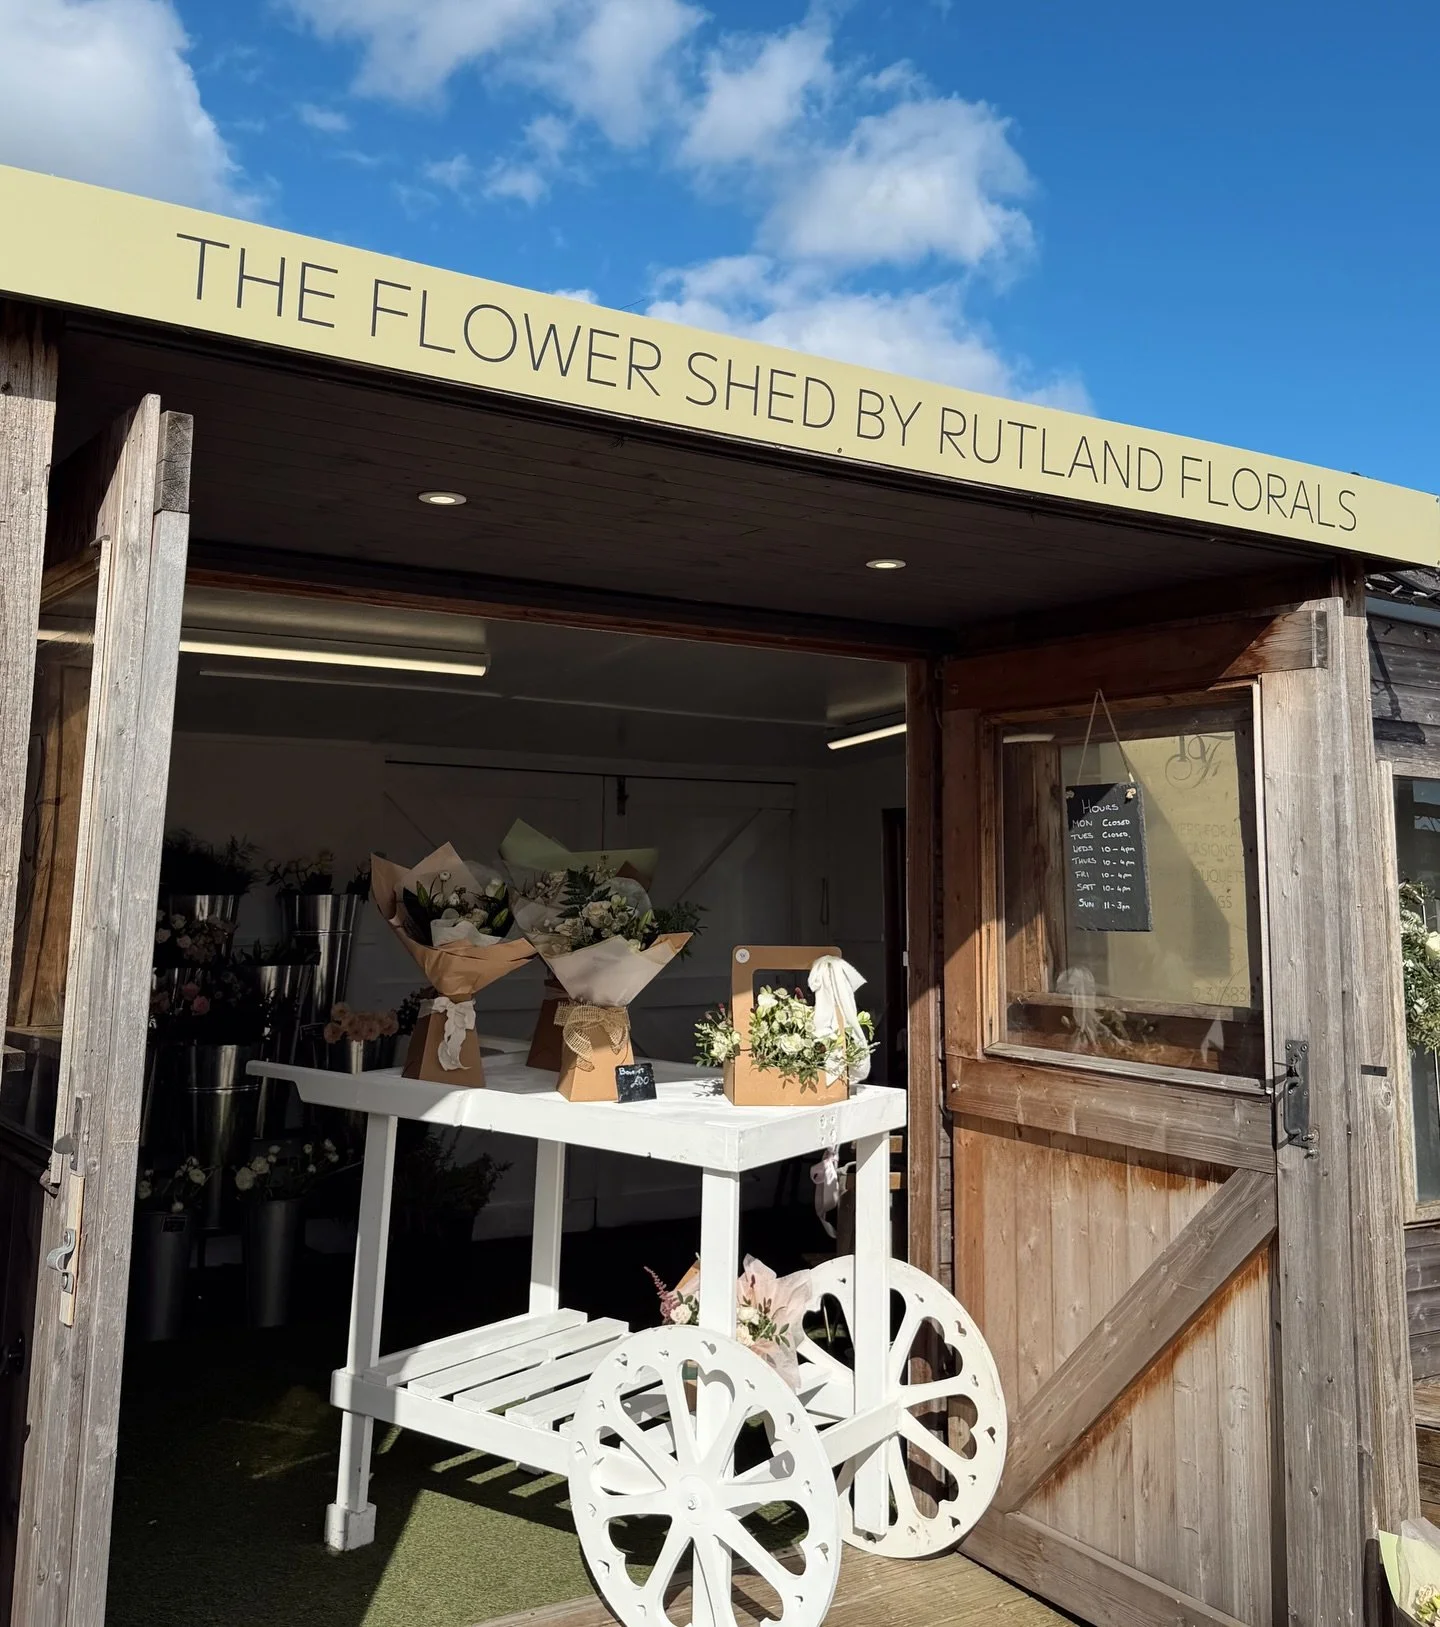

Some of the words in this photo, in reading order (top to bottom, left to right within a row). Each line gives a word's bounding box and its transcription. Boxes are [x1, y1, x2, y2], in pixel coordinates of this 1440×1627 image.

[176, 232, 339, 329] THE
[370, 278, 662, 397] FLOWER
[685, 351, 836, 430] SHED
[856, 388, 923, 447] BY
[939, 406, 1164, 492] RUTLAND
[1181, 455, 1358, 532] FLORALS
[1072, 820, 1093, 828] MON
[1071, 832, 1094, 840] TUES
[1071, 856, 1097, 864] THURS
[1075, 870, 1090, 878] FRI
[1076, 883, 1097, 892] SAT
[1078, 898, 1095, 908] SUN
